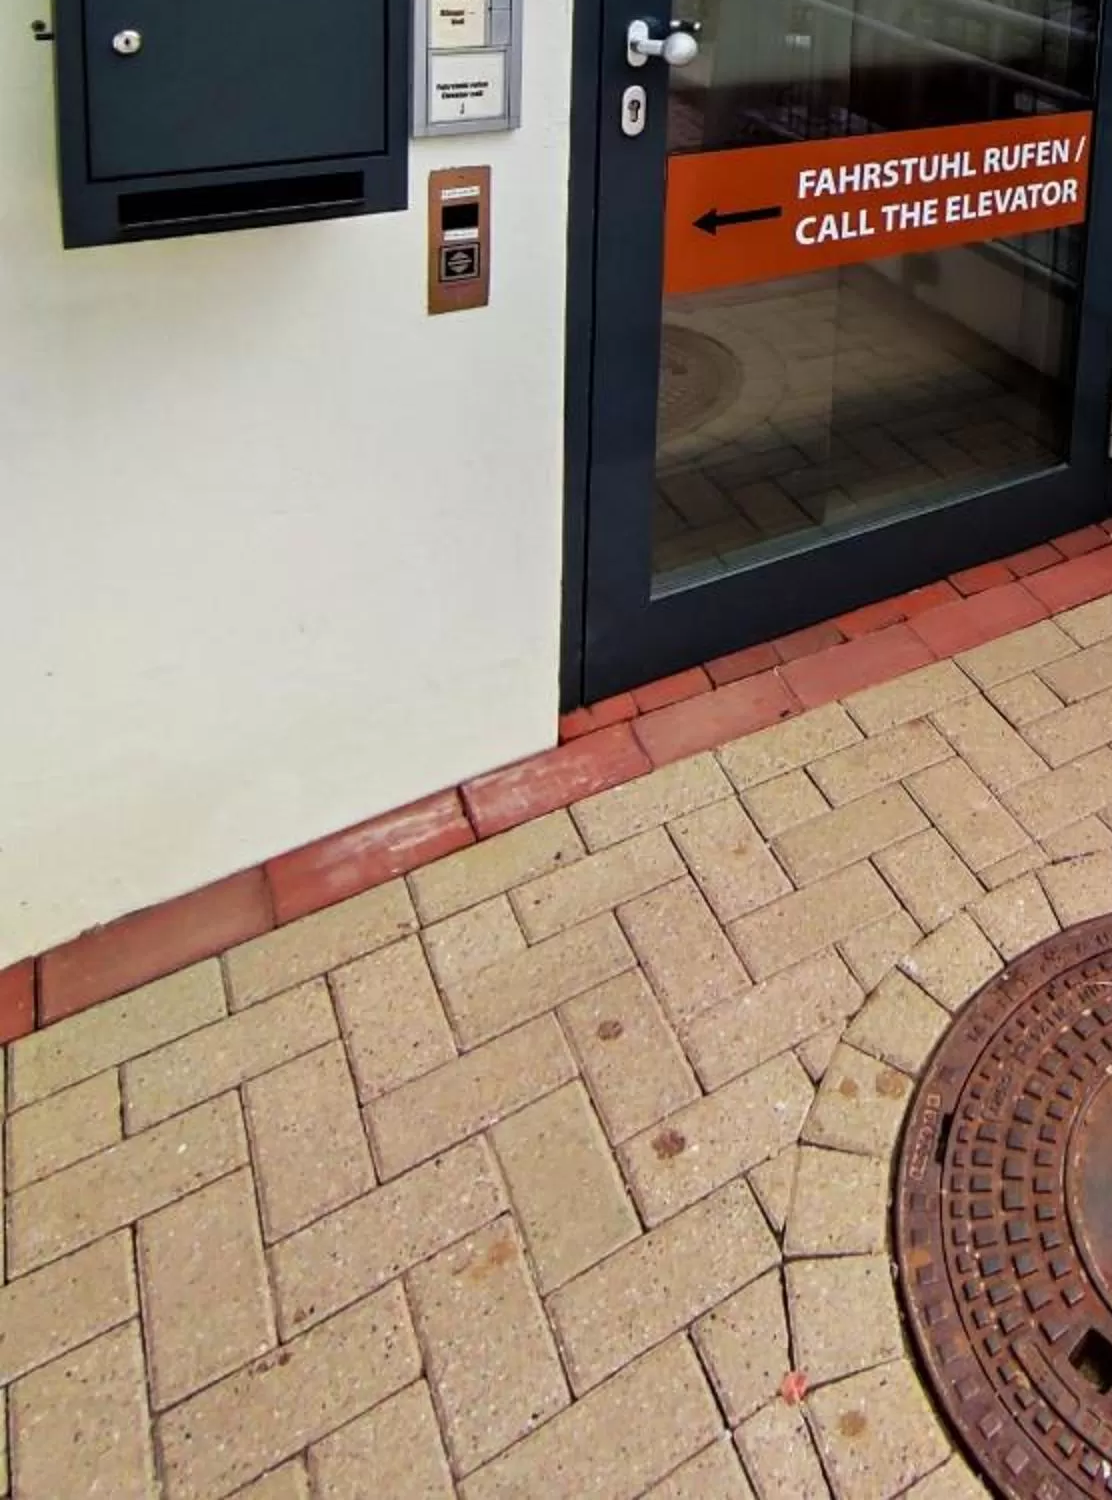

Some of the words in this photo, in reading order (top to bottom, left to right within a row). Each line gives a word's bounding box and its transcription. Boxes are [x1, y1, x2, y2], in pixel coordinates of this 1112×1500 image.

[798, 151, 976, 199] FAHRSTUHL
[983, 139, 1070, 175] RUFEN
[1075, 136, 1086, 162] /
[795, 210, 876, 245] CALL
[881, 199, 938, 231] THE
[945, 178, 1078, 222] ELEVATOR
